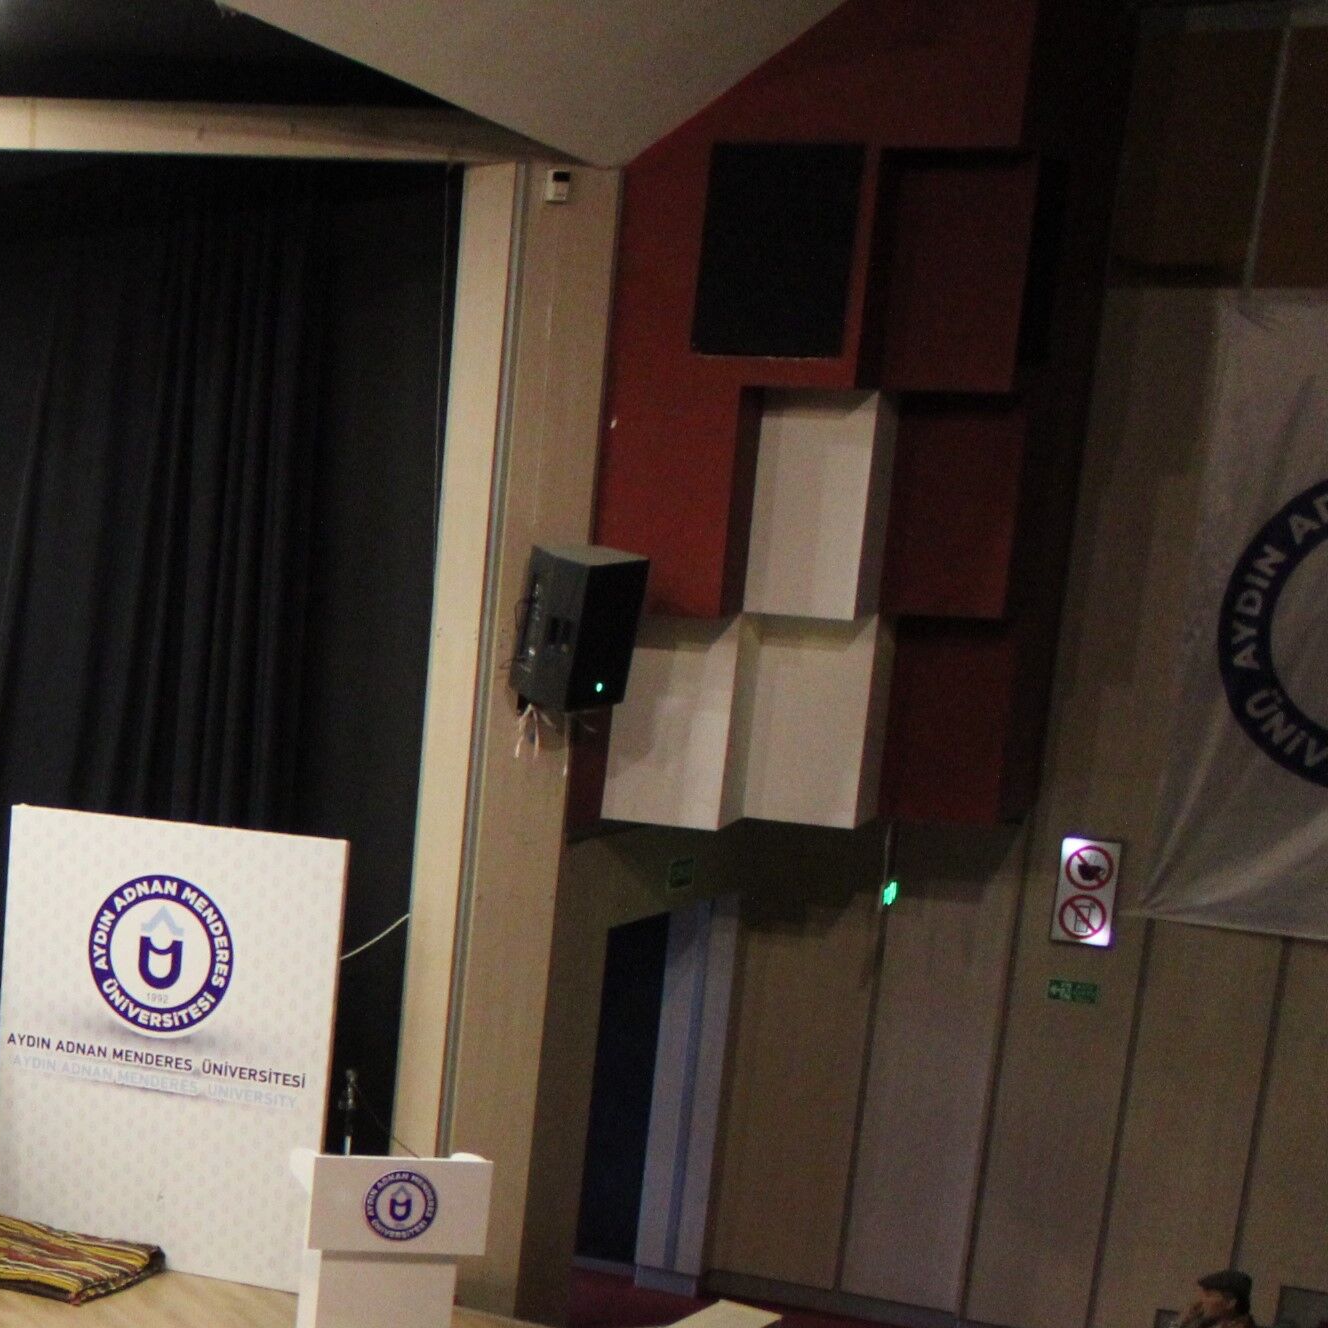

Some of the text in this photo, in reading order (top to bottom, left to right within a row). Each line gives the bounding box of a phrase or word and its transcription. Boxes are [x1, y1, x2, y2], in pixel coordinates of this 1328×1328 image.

[1232, 543, 1287, 670] AYDIN
[93, 879, 230, 988] AYDIN ADNAN MENDERES
[7, 1033, 306, 1088] AYDIN ADNAN MENDERES ÜNİVERSİTESİ
[13, 1055, 298, 1109] AYDIN ADNAN MENDERES UNIVERSITY
